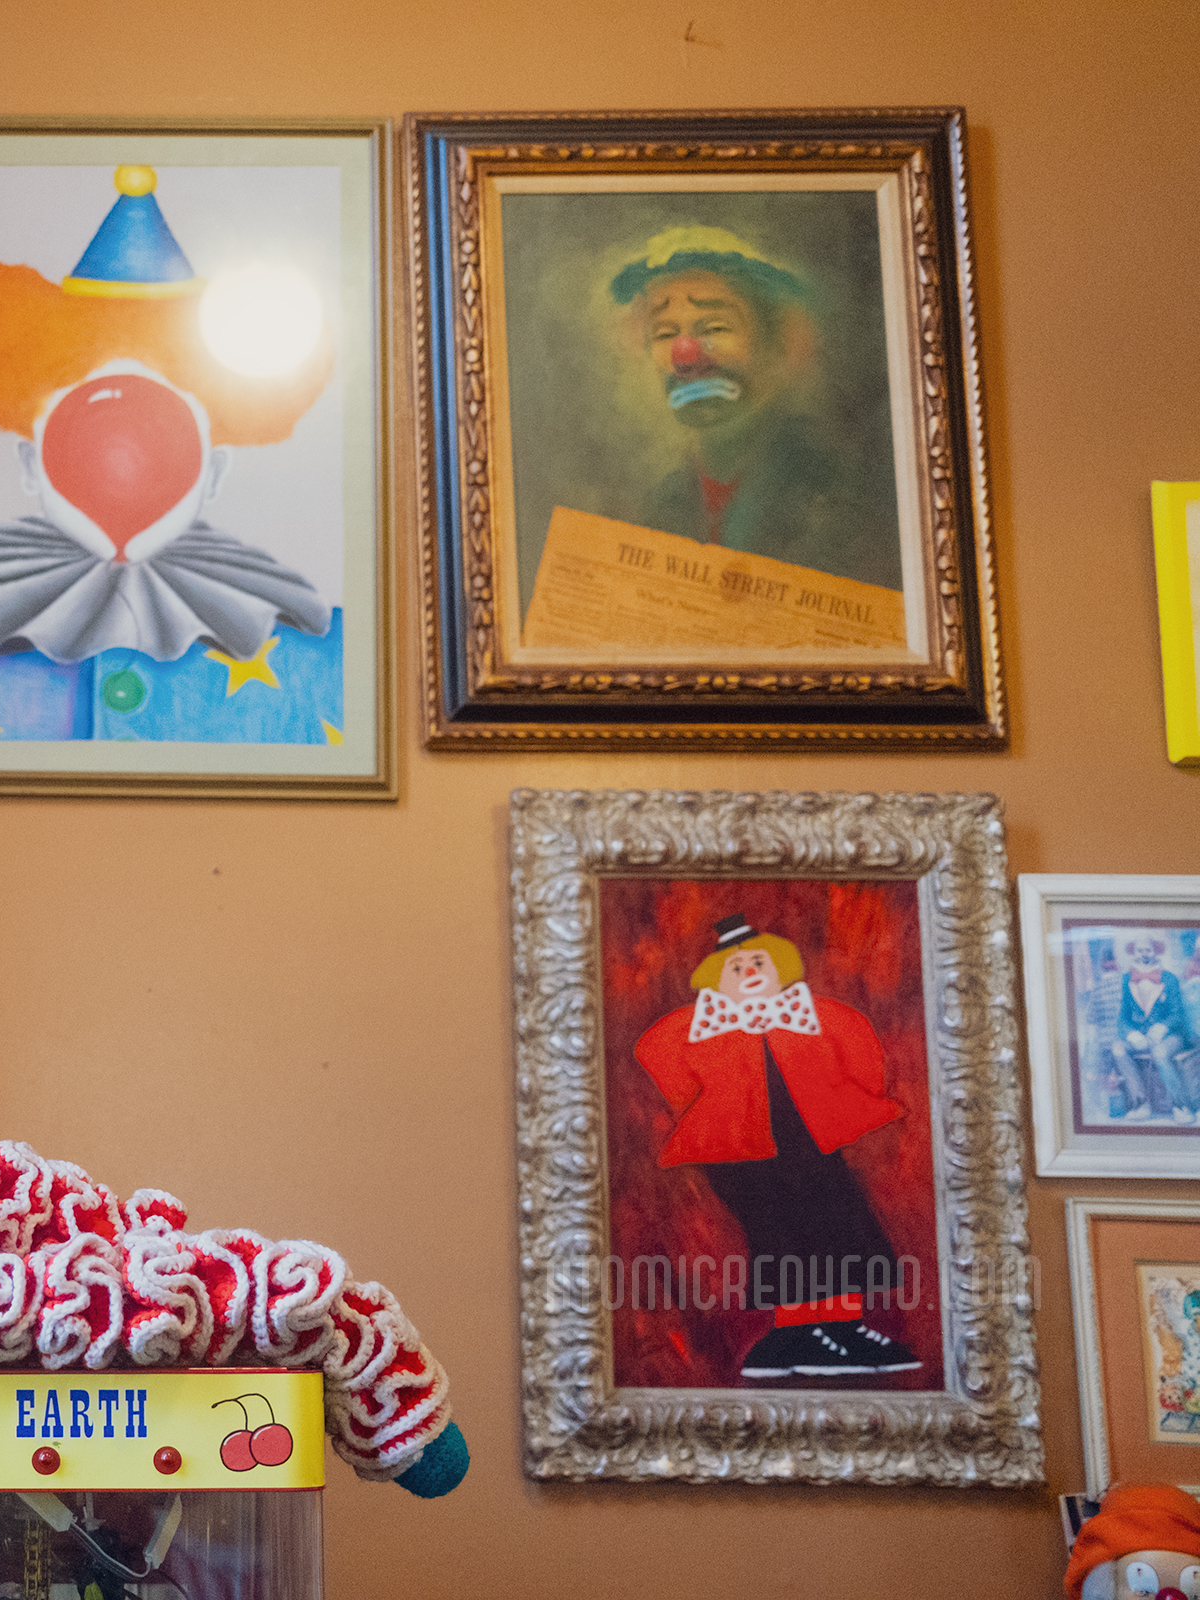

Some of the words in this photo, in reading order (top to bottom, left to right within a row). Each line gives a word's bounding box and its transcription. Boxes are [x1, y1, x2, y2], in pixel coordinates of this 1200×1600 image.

[617, 542, 654, 570] THE
[665, 554, 711, 584] WALL
[720, 570, 789, 602] STREET
[795, 587, 874, 624] JOURNAL
[16, 1388, 148, 1438] EARTH
